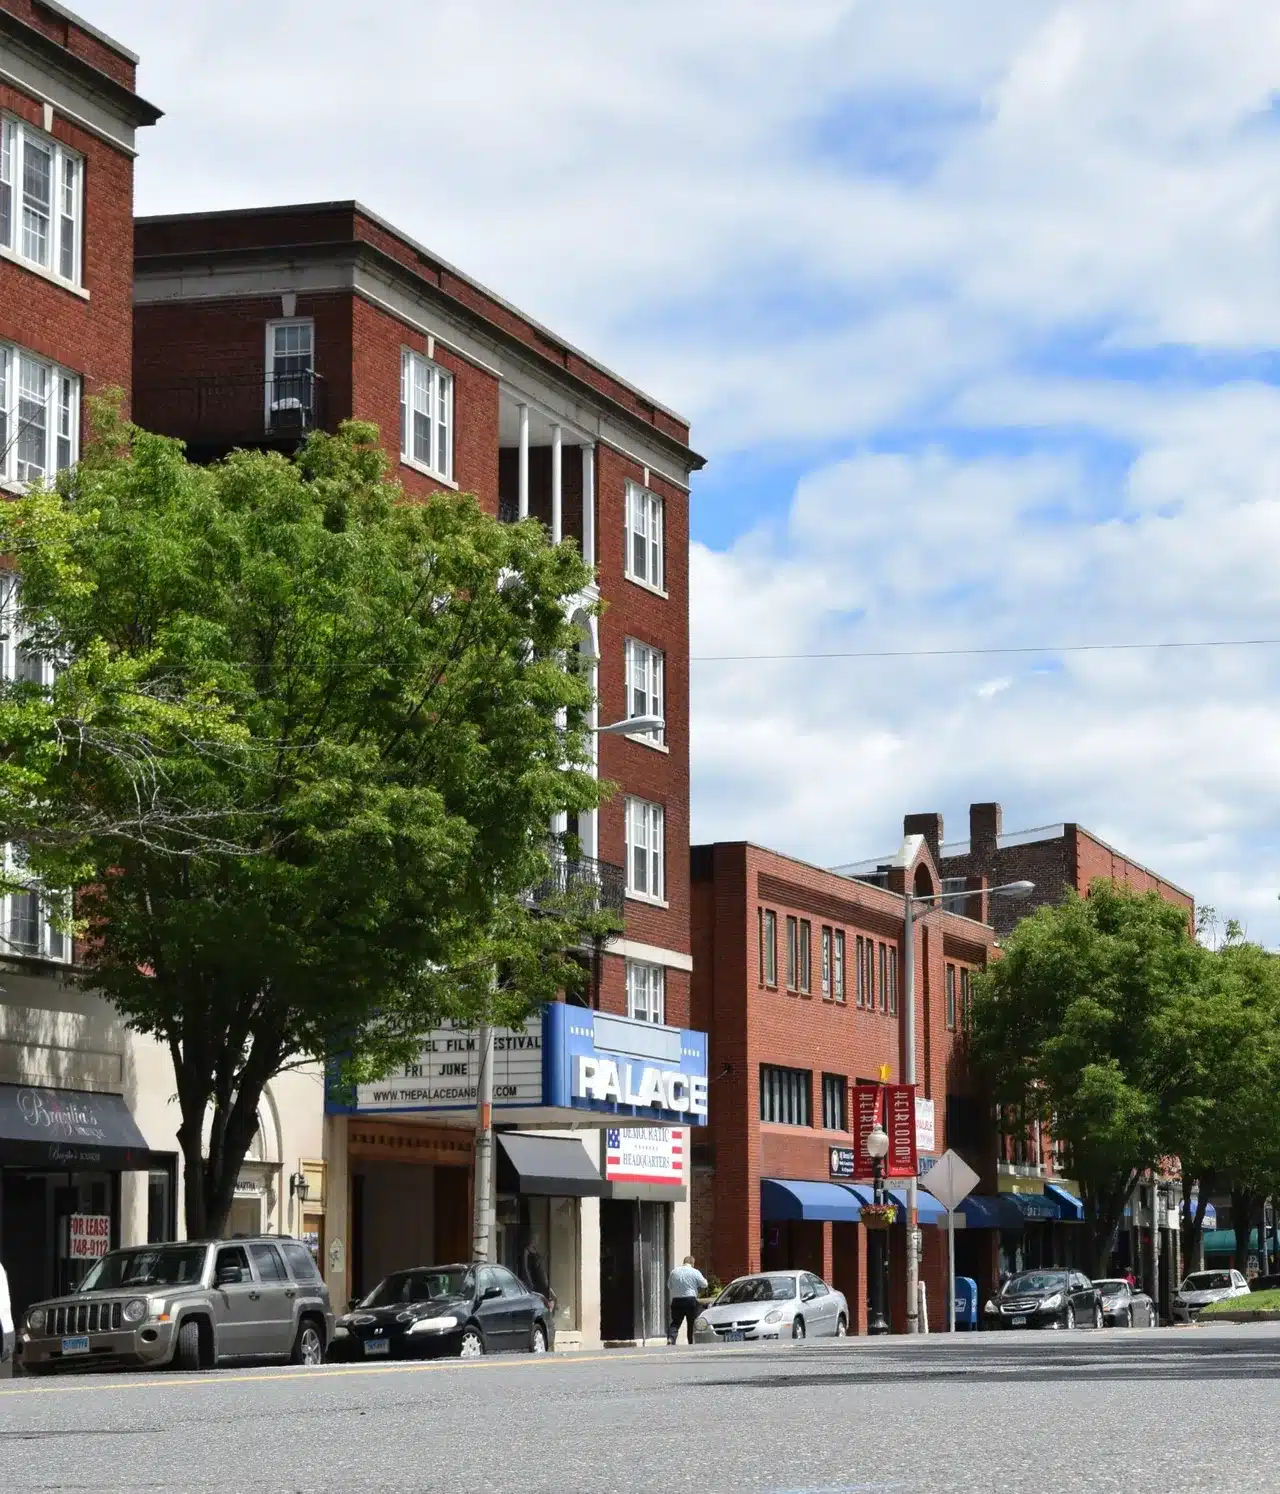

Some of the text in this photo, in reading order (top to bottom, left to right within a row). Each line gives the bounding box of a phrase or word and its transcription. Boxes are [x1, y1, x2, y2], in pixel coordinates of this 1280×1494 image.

[447, 1039, 475, 1051] FILM
[494, 1037, 540, 1050] ESTIVAL
[405, 1063, 468, 1077] FRI JUNE
[572, 1054, 708, 1115] PALACE
[894, 1091, 911, 1156] HEIRLOOM
[622, 1127, 669, 1142] DEMOCRATIC
[622, 1153, 670, 1168] HEADQUARTERS
[71, 1218, 108, 1236] OR LEASE
